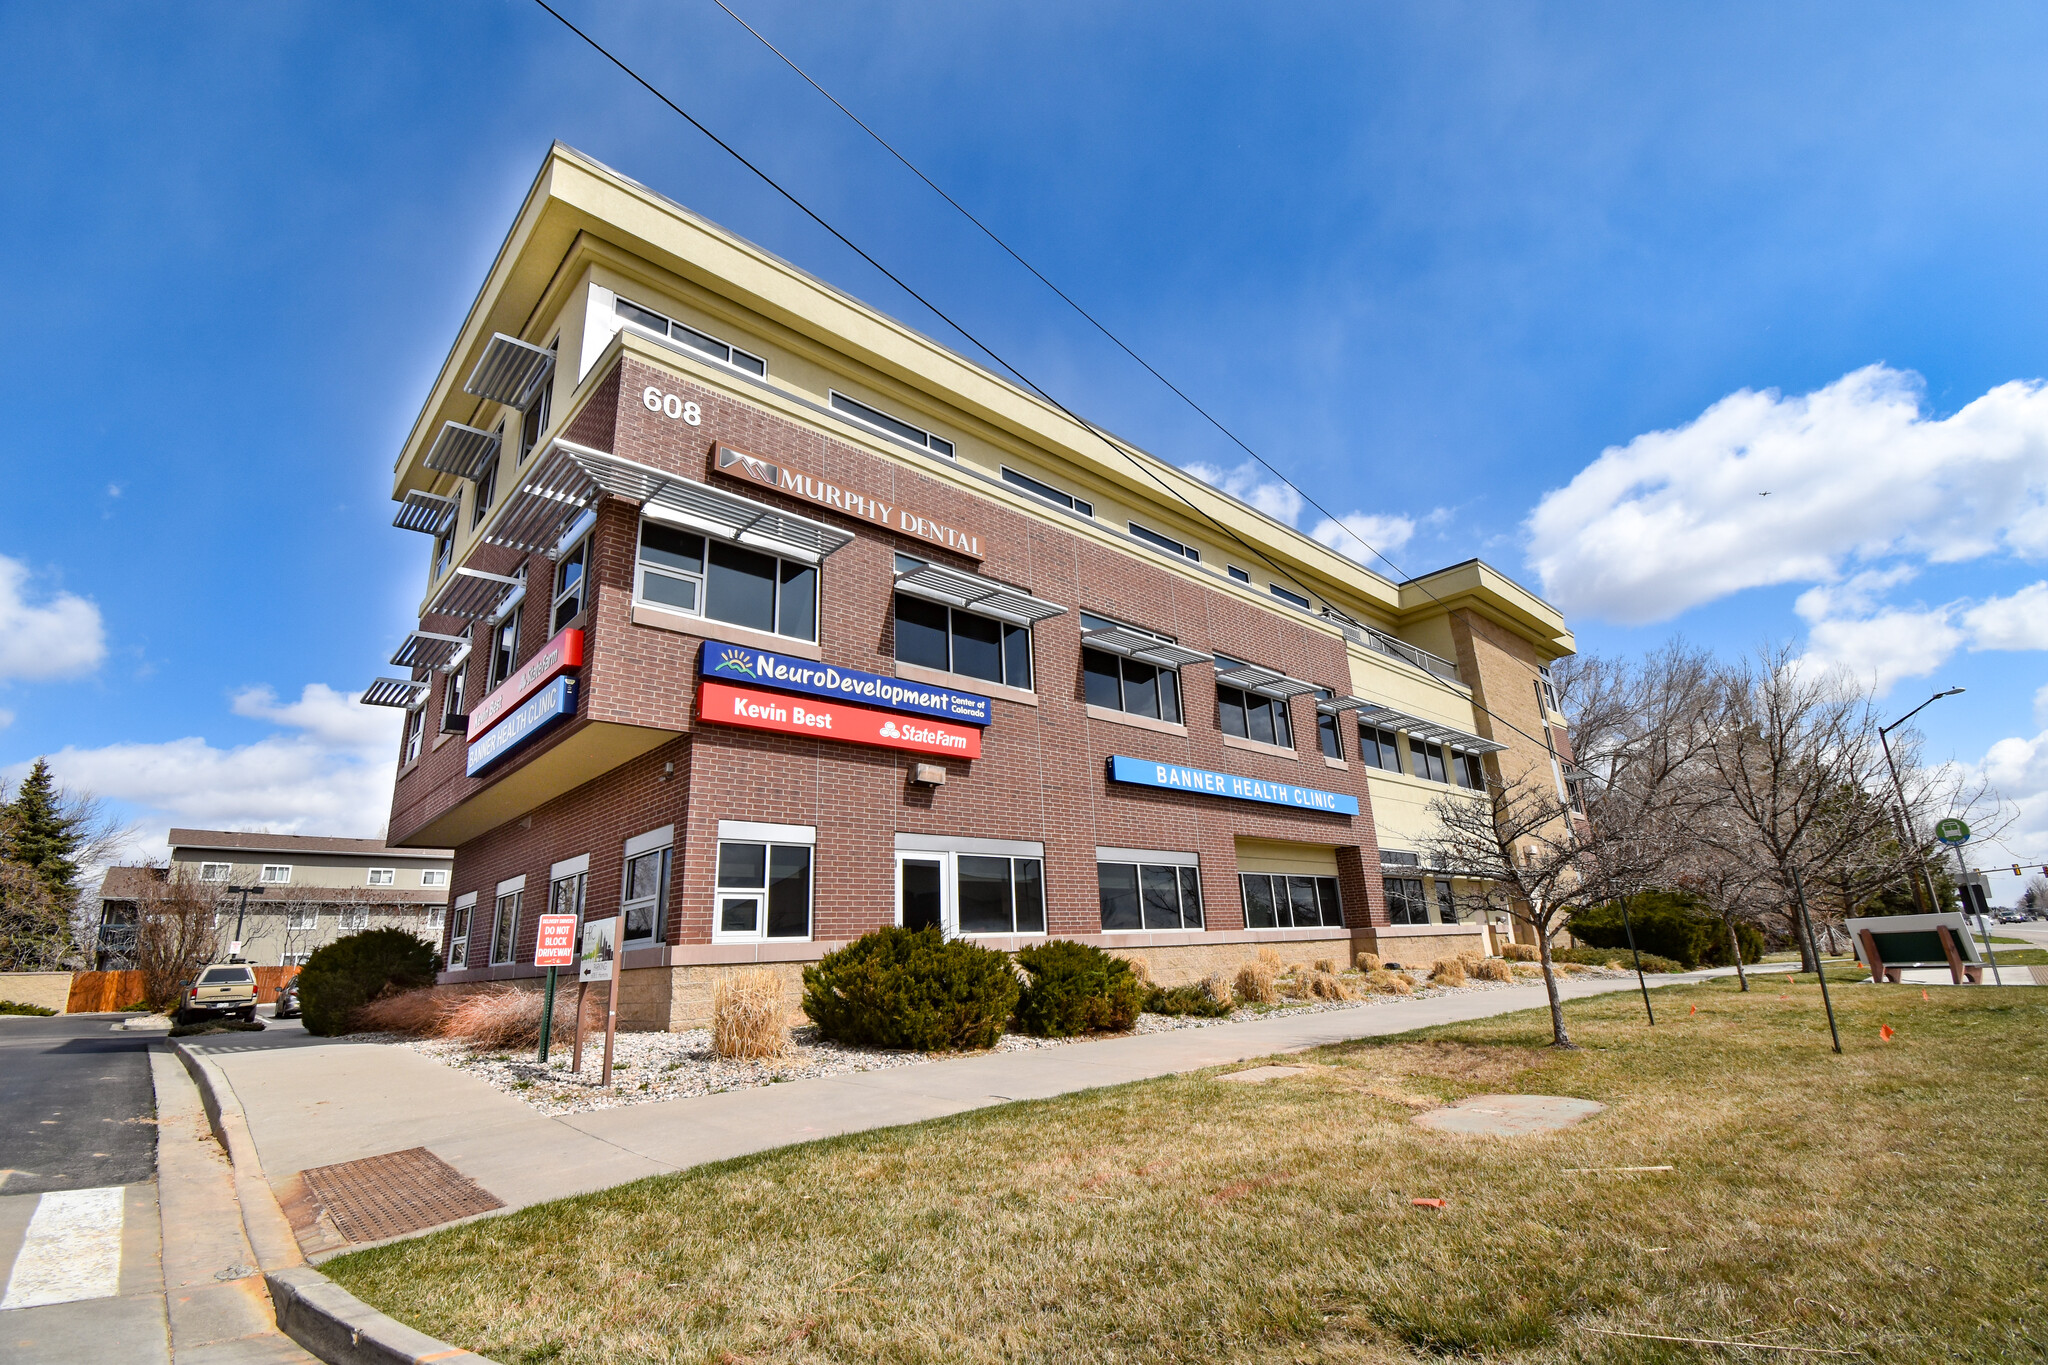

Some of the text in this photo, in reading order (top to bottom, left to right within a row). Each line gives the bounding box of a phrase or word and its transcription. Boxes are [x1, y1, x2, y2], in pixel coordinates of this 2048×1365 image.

[643, 386, 702, 426] 608
[780, 468, 984, 557] MURPHY DENTAL
[756, 655, 949, 711] NeuroDevelopment
[734, 697, 832, 729] Kevin Best
[951, 695, 986, 709] Center of
[951, 705, 985, 718] Colorado
[469, 687, 558, 768] BANNER HEALTH CLINIC
[1156, 765, 1336, 809] BANNER HEALTH CLINIC
[544, 926, 570, 935] DO NOT
[545, 937, 567, 946] BLOCK
[538, 948, 572, 957] DRIVEWAY
